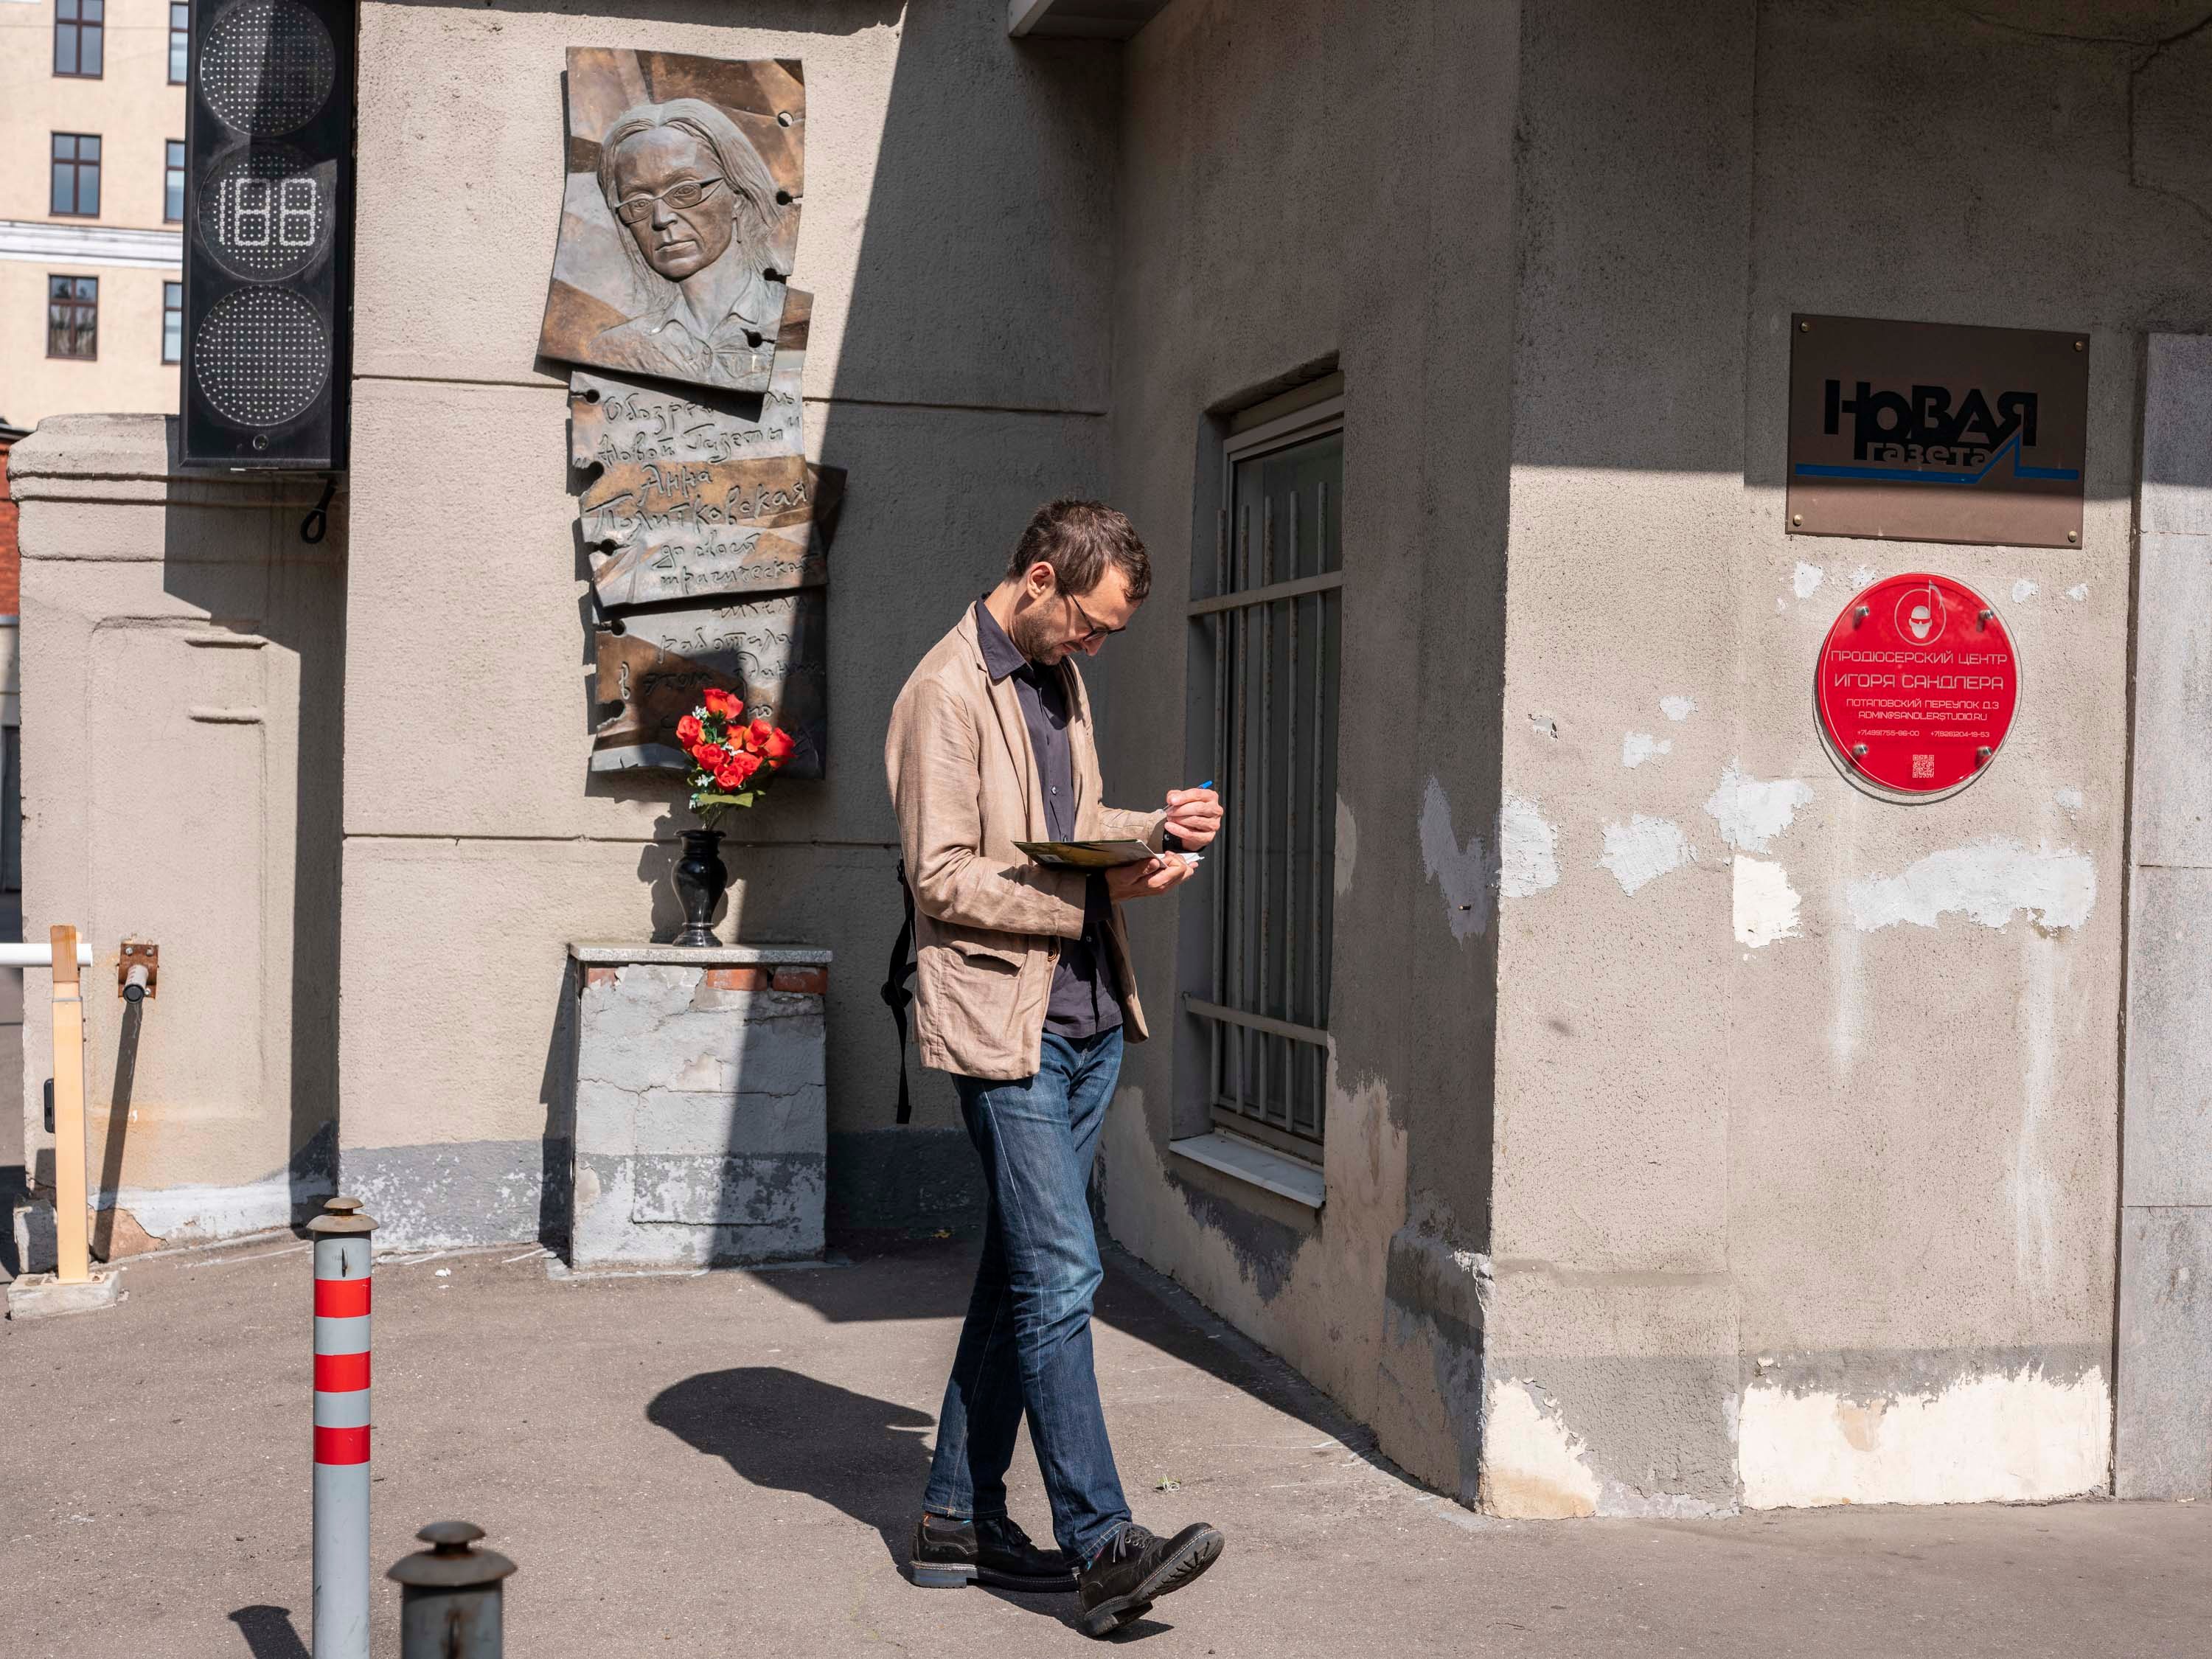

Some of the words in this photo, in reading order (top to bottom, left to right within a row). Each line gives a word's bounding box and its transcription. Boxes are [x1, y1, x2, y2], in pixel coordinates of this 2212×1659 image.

[637, 463, 712, 507] Анна
[585, 478, 809, 541] Политковская
[1831, 650, 1954, 664] ПРОДЮСЕРСКИЙ
[1958, 653, 2008, 666] ЦЕНТР
[1834, 673, 1896, 688] ИГОРЯ
[1902, 674, 2004, 690] САНДЛЕРА
[1846, 698, 1921, 708] ПОТАПОВСКИЙ
[1924, 700, 1979, 709] ПЕРЕУЛОК
[1858, 711, 1987, 721] ADMIN@SANDLERSTUDIO.RU
